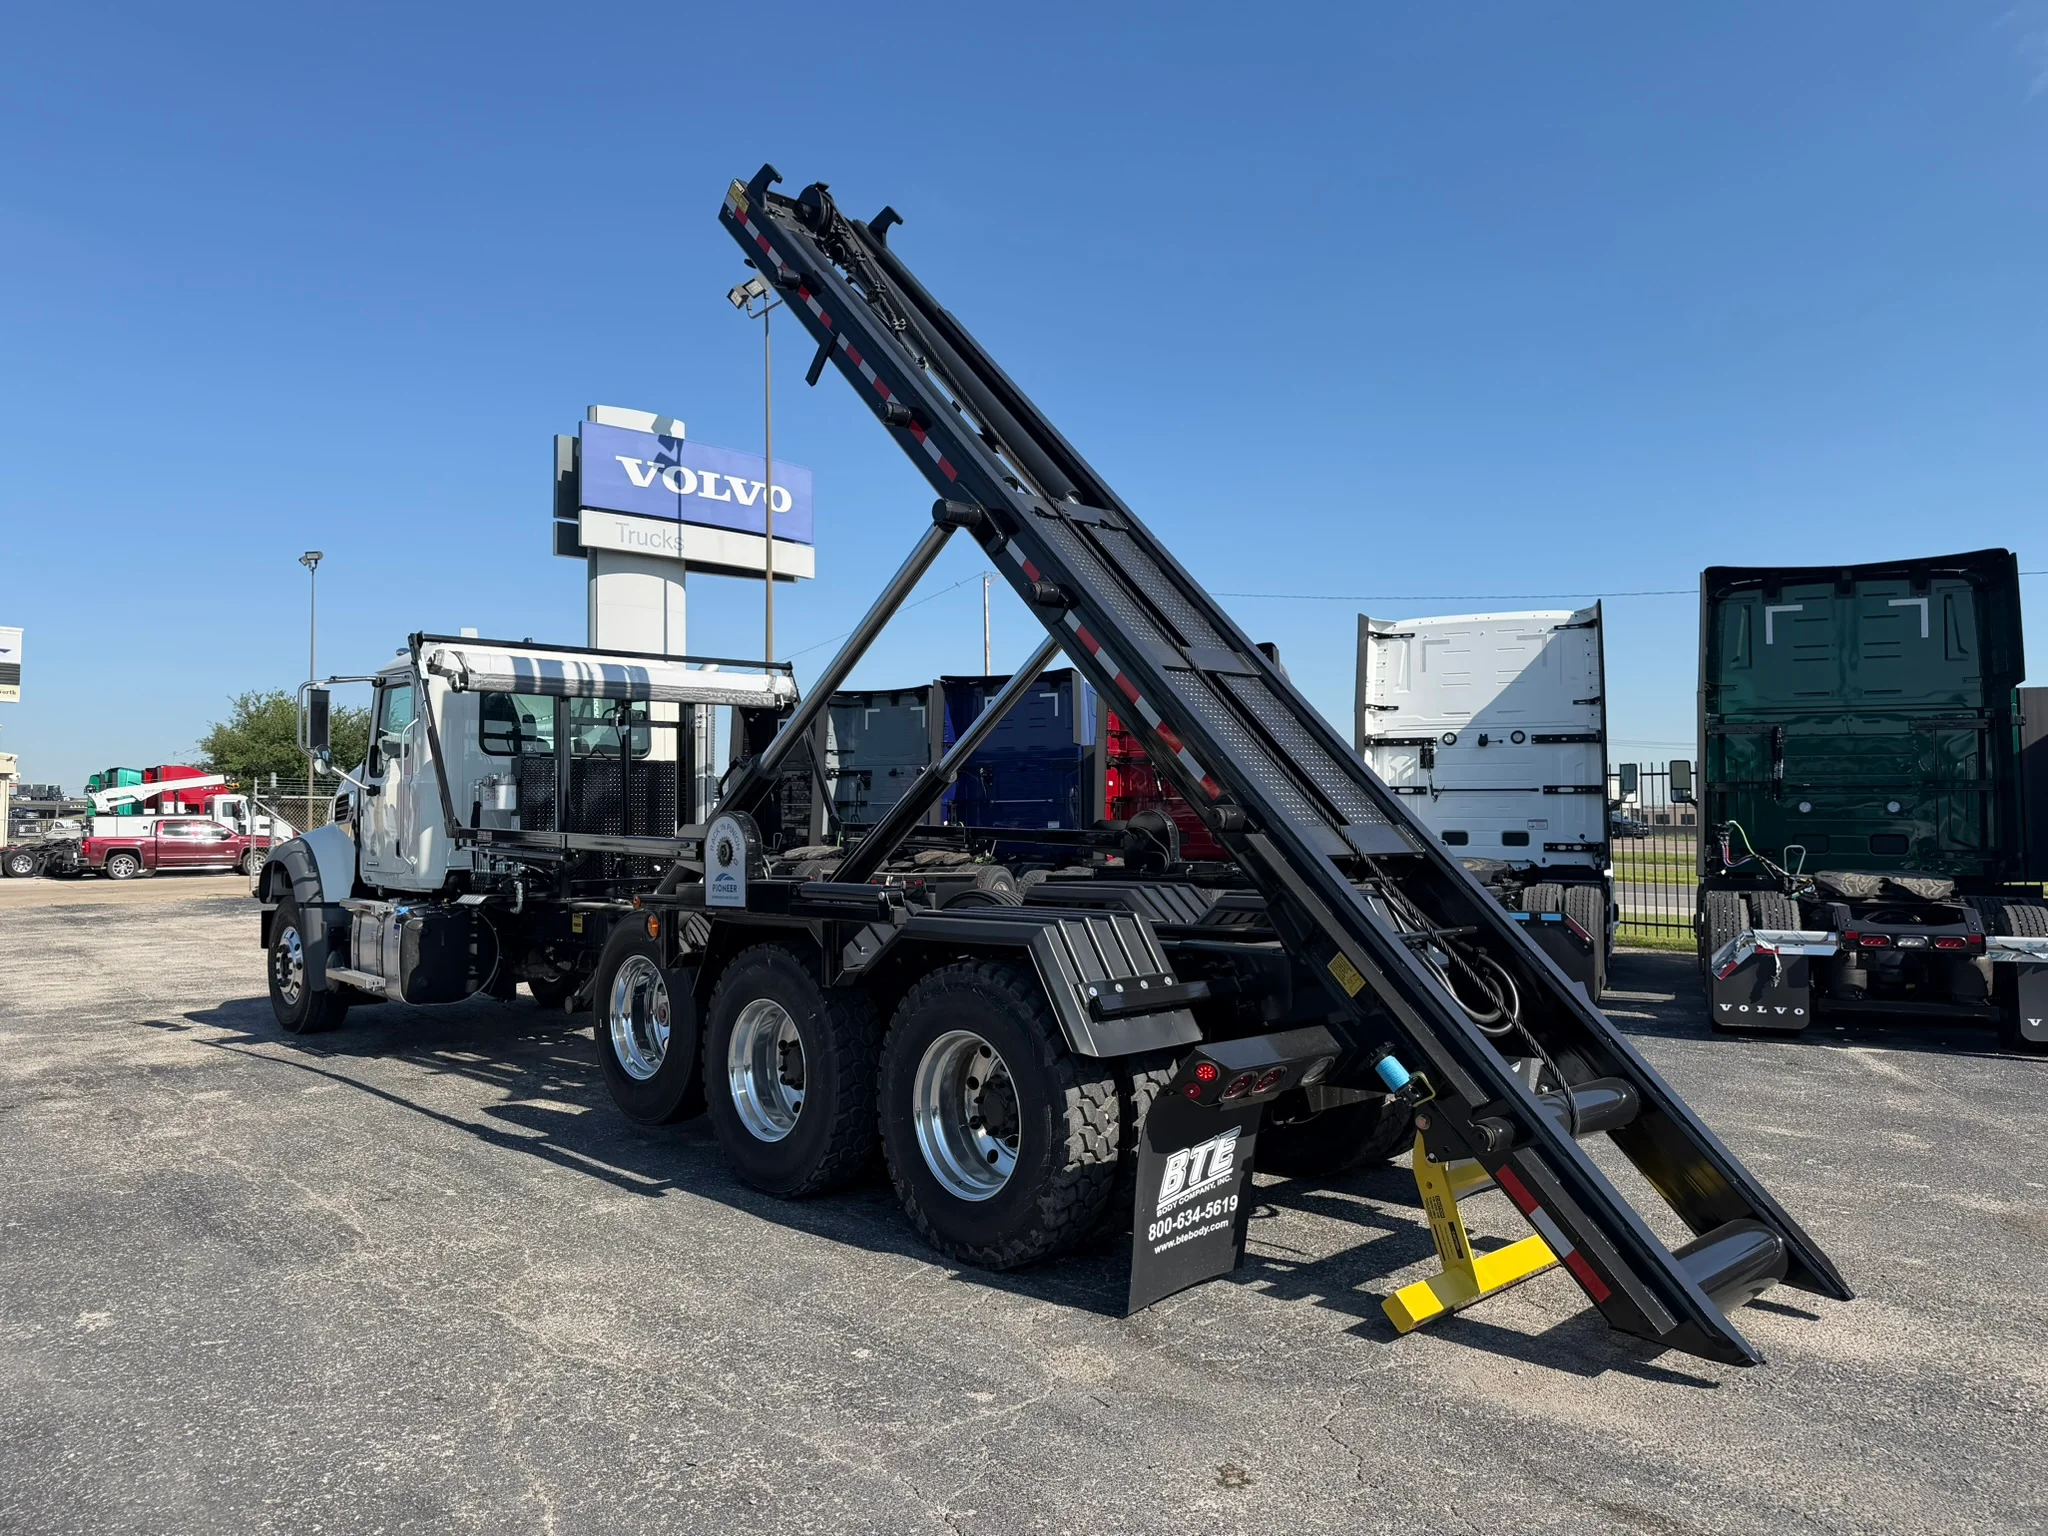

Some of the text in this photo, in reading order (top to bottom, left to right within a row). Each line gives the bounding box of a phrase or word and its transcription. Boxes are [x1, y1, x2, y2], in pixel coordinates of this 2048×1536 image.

[615, 455, 793, 513] VOLVO
[615, 521, 685, 551] Trucks
[712, 884, 738, 893] PIONEER
[1719, 1003, 1805, 1016] VOLVO
[1158, 1124, 1242, 1204] BTE
[1156, 1174, 1233, 1218] BODY COMPANY, INC.
[1148, 1194, 1239, 1242] 800-634-5619
[1154, 1219, 1229, 1255] www.btebody.com
